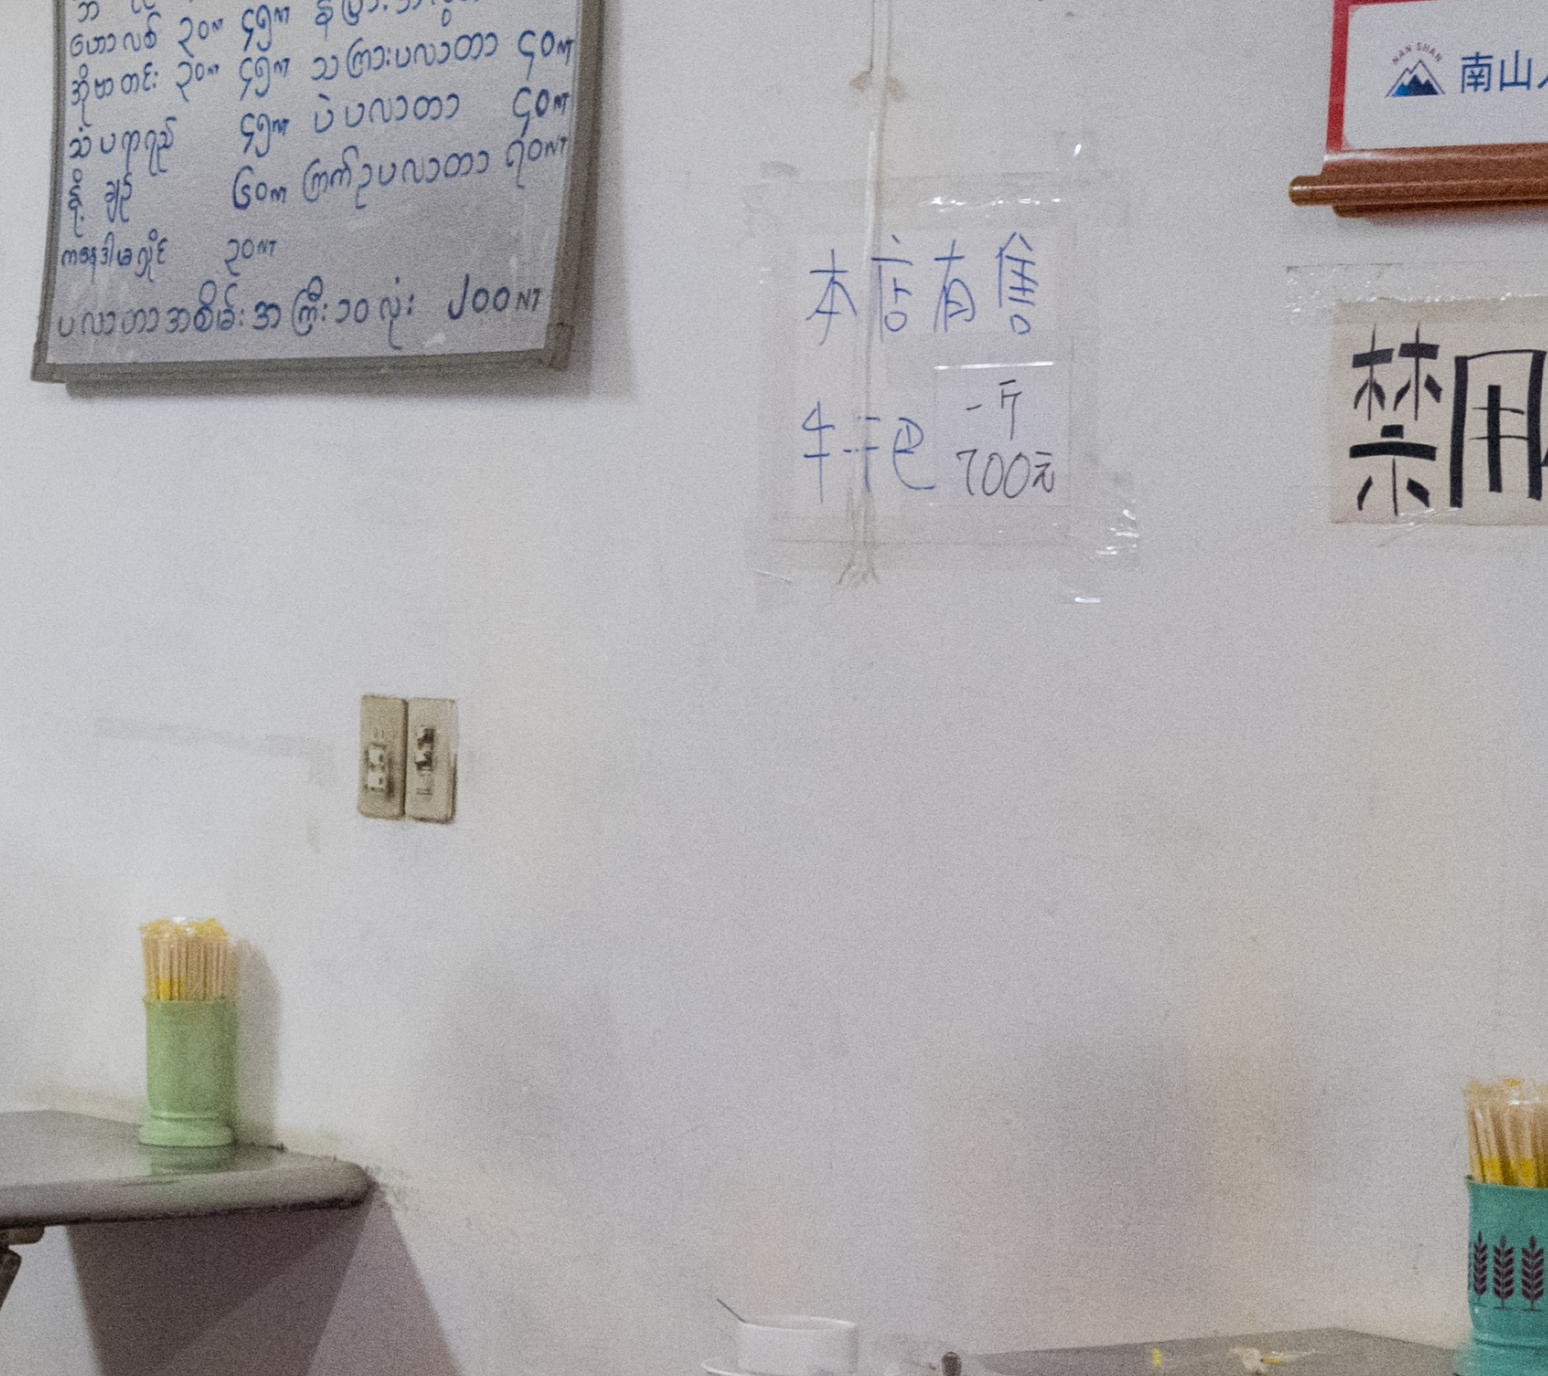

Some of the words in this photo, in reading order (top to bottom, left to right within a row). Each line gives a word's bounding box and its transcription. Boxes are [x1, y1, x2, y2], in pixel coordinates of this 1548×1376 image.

[1392, 43, 1412, 65] NAN
[1416, 41, 1444, 63] SHAN
[803, 233, 1040, 346] 本店有售
[956, 448, 1057, 502] 700元
